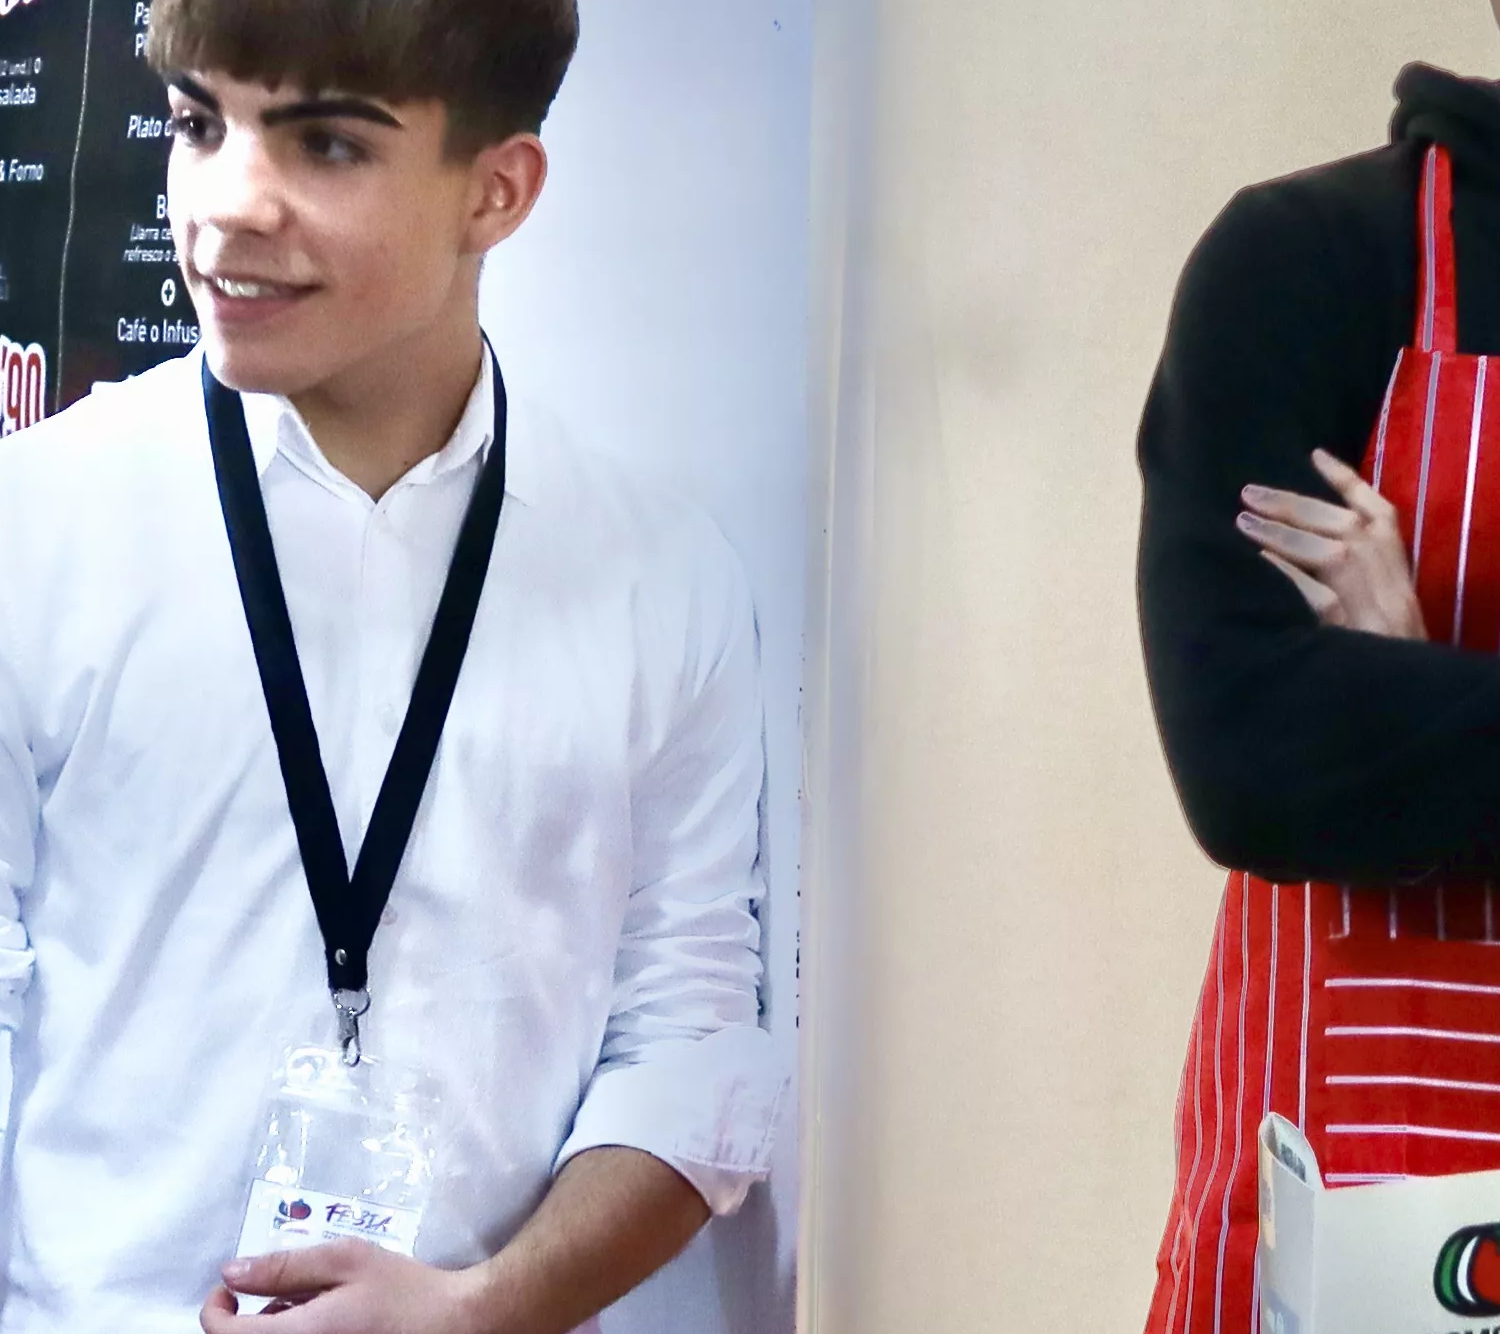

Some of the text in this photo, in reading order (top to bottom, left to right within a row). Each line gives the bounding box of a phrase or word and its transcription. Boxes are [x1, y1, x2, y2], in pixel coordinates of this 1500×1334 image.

[127, 114, 161, 139] Plato
[8, 159, 44, 182] Forno
[117, 317, 147, 342] Café
[151, 326, 159, 343] o
